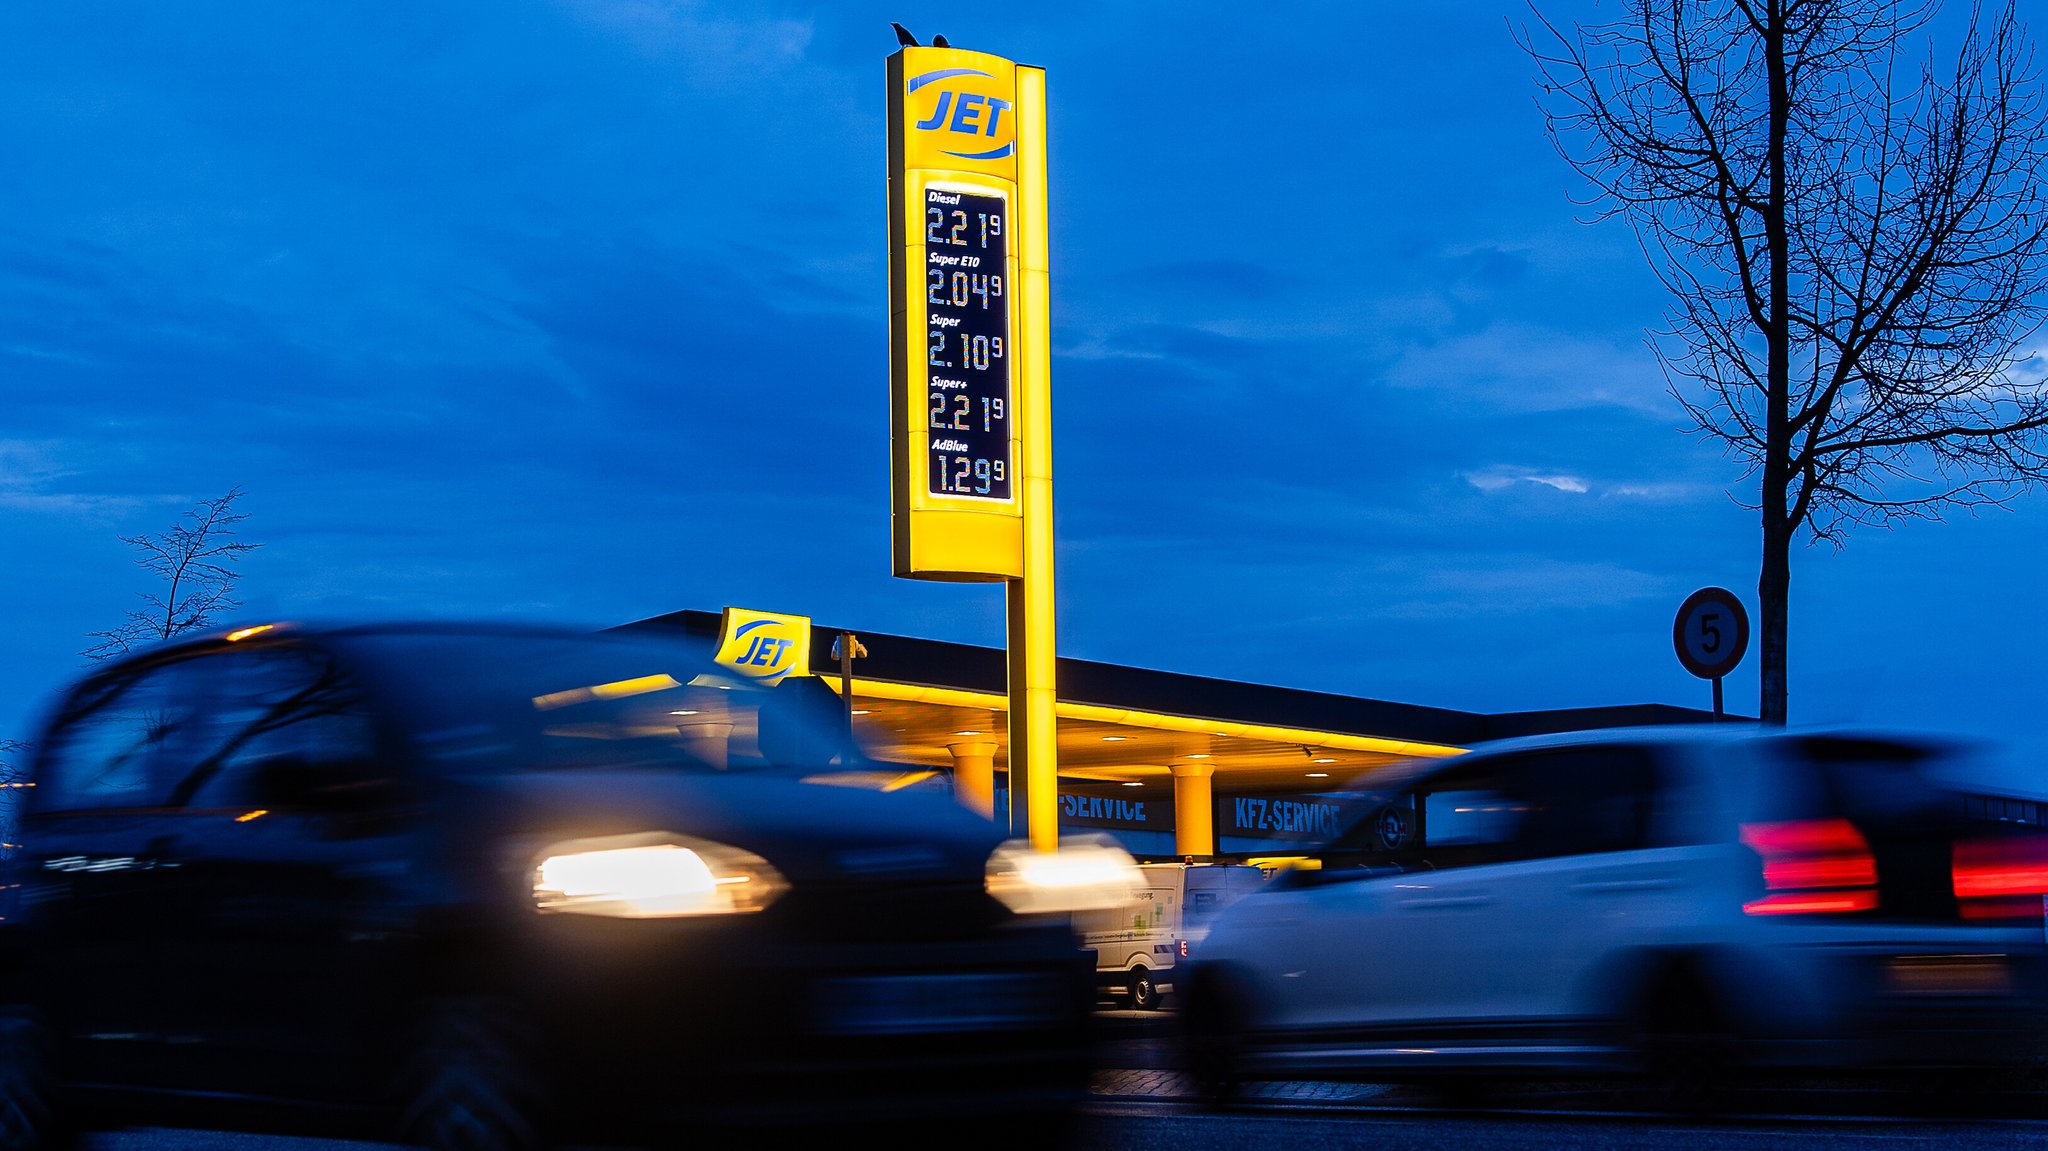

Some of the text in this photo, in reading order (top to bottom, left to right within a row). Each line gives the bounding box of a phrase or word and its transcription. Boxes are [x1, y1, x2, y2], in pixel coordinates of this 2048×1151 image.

[916, 91, 1013, 138] JET
[928, 192, 961, 206] Diesel
[929, 252, 980, 268] Super E10
[930, 314, 961, 328] Super
[930, 375, 968, 390] Super+
[931, 438, 969, 452] AdBlue
[1701, 613, 1720, 654] 5
[735, 636, 794, 668] JET
[1235, 797, 1341, 838] KFZ-SERVICE
[1260, 866, 1280, 881] ET
